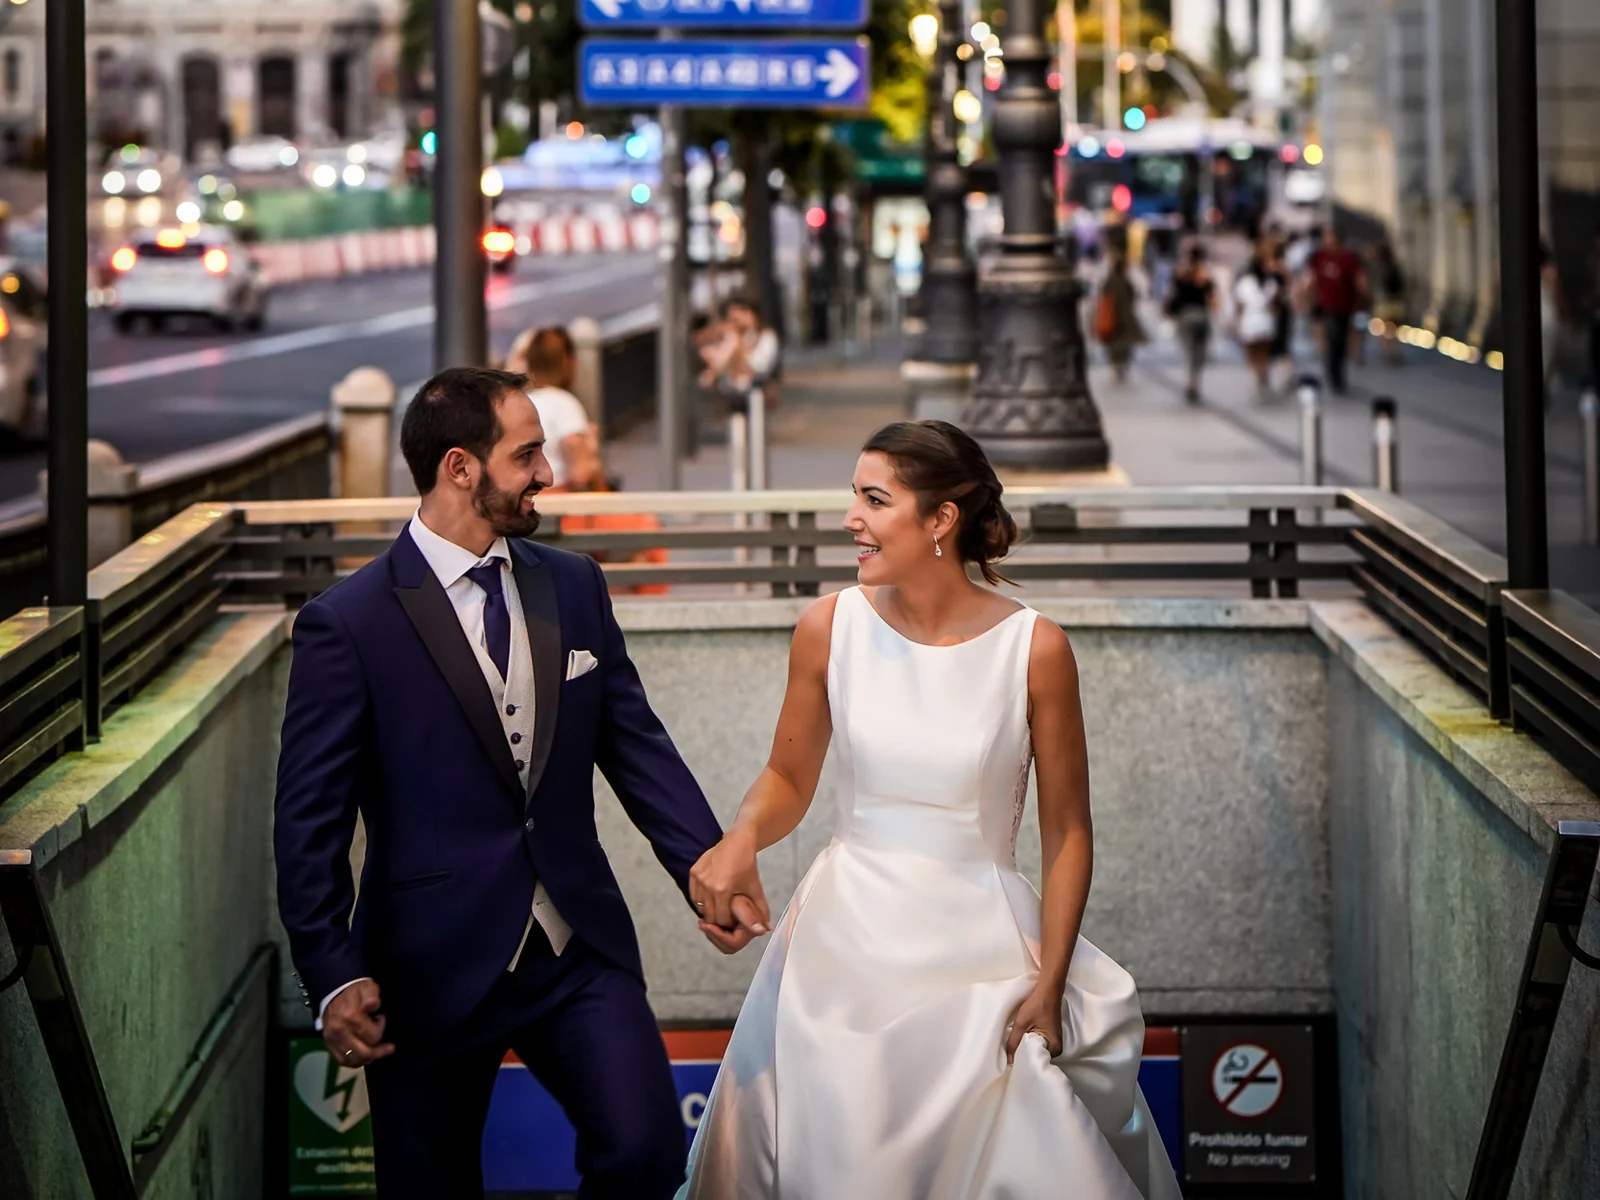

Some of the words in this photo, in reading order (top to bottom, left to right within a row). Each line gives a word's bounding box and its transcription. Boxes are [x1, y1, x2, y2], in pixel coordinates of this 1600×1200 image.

[1189, 1131, 1262, 1147] Prohibido
[1264, 1133, 1308, 1147] fumar
[1207, 1152, 1229, 1166] No
[1231, 1153, 1291, 1170] smoking
